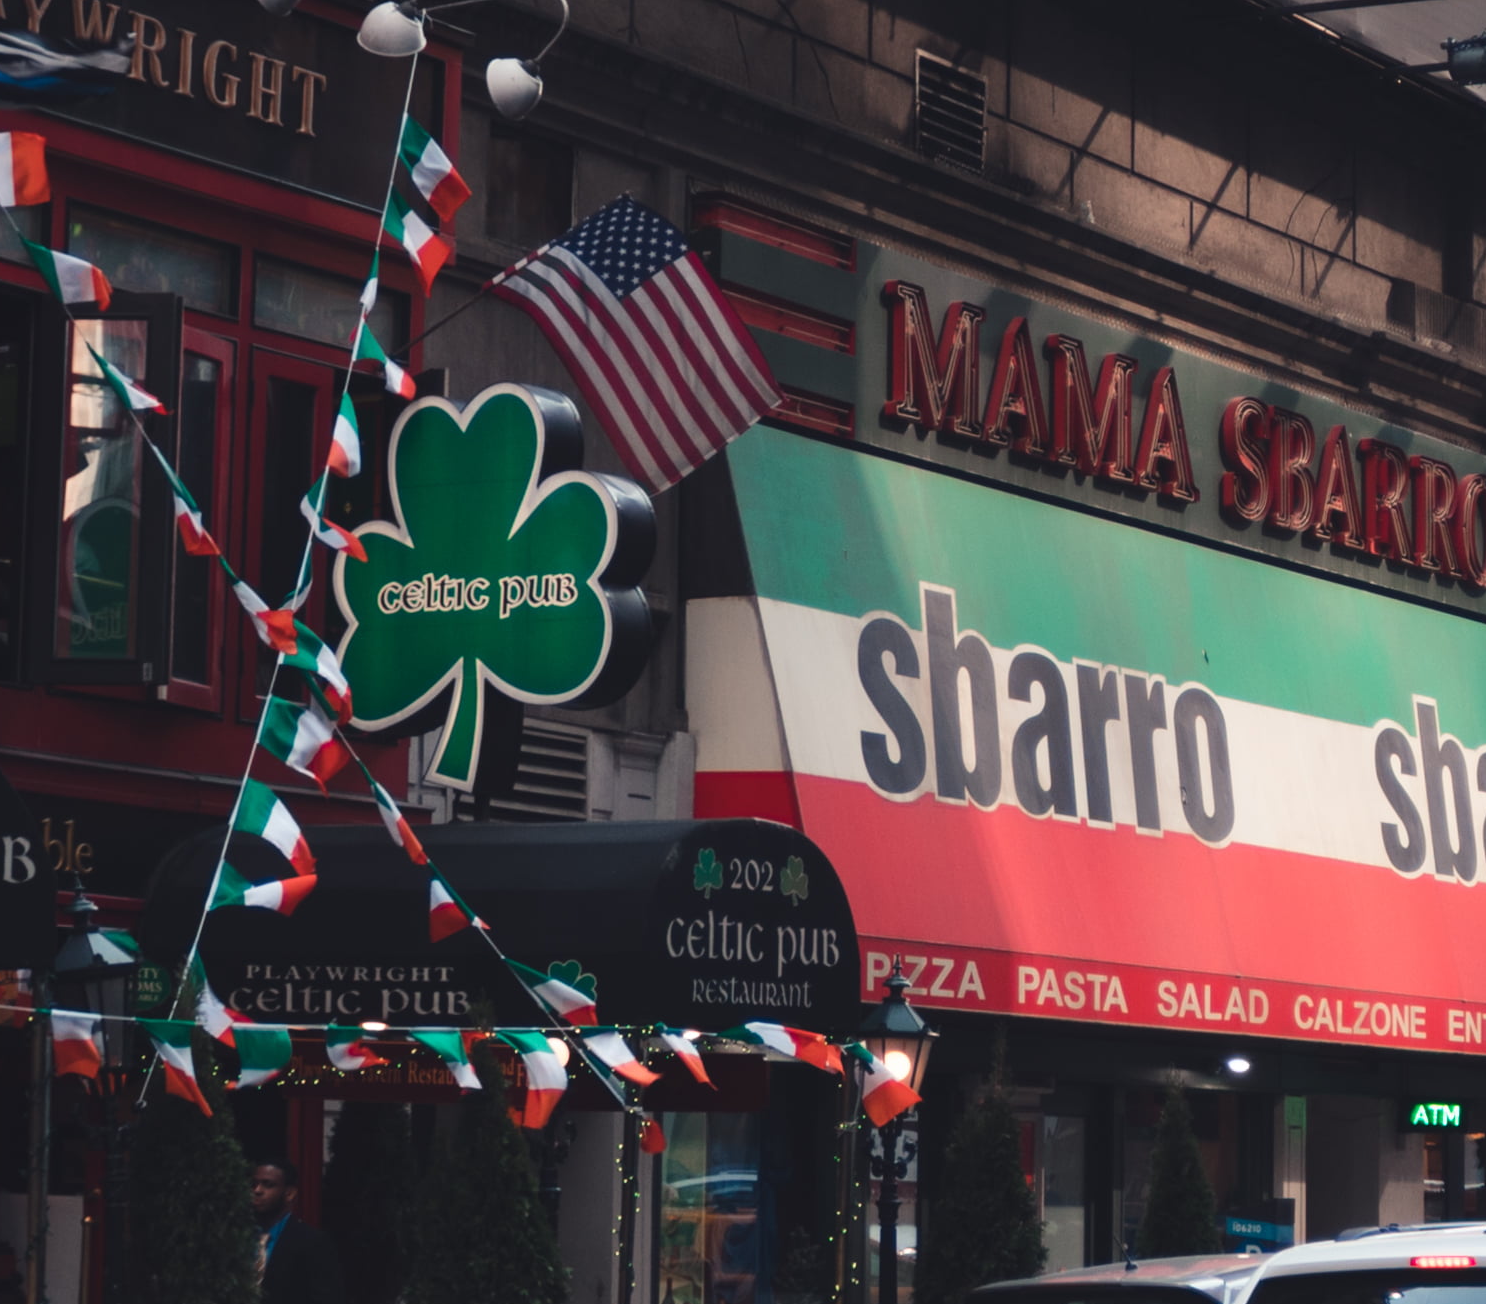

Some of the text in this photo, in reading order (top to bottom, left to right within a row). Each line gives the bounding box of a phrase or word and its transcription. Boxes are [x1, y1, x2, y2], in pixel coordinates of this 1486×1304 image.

[882, 278, 1200, 503] MAMA
[856, 581, 1236, 846] sbarro
[729, 856, 775, 893] 202
[245, 963, 455, 984] PLAYWRIGHT
[1017, 965, 1129, 1014] PASTA
[1156, 979, 1269, 1025] SALAD
[1291, 994, 1427, 1040] CALZONE
[1409, 1102, 1462, 1130] ATM
